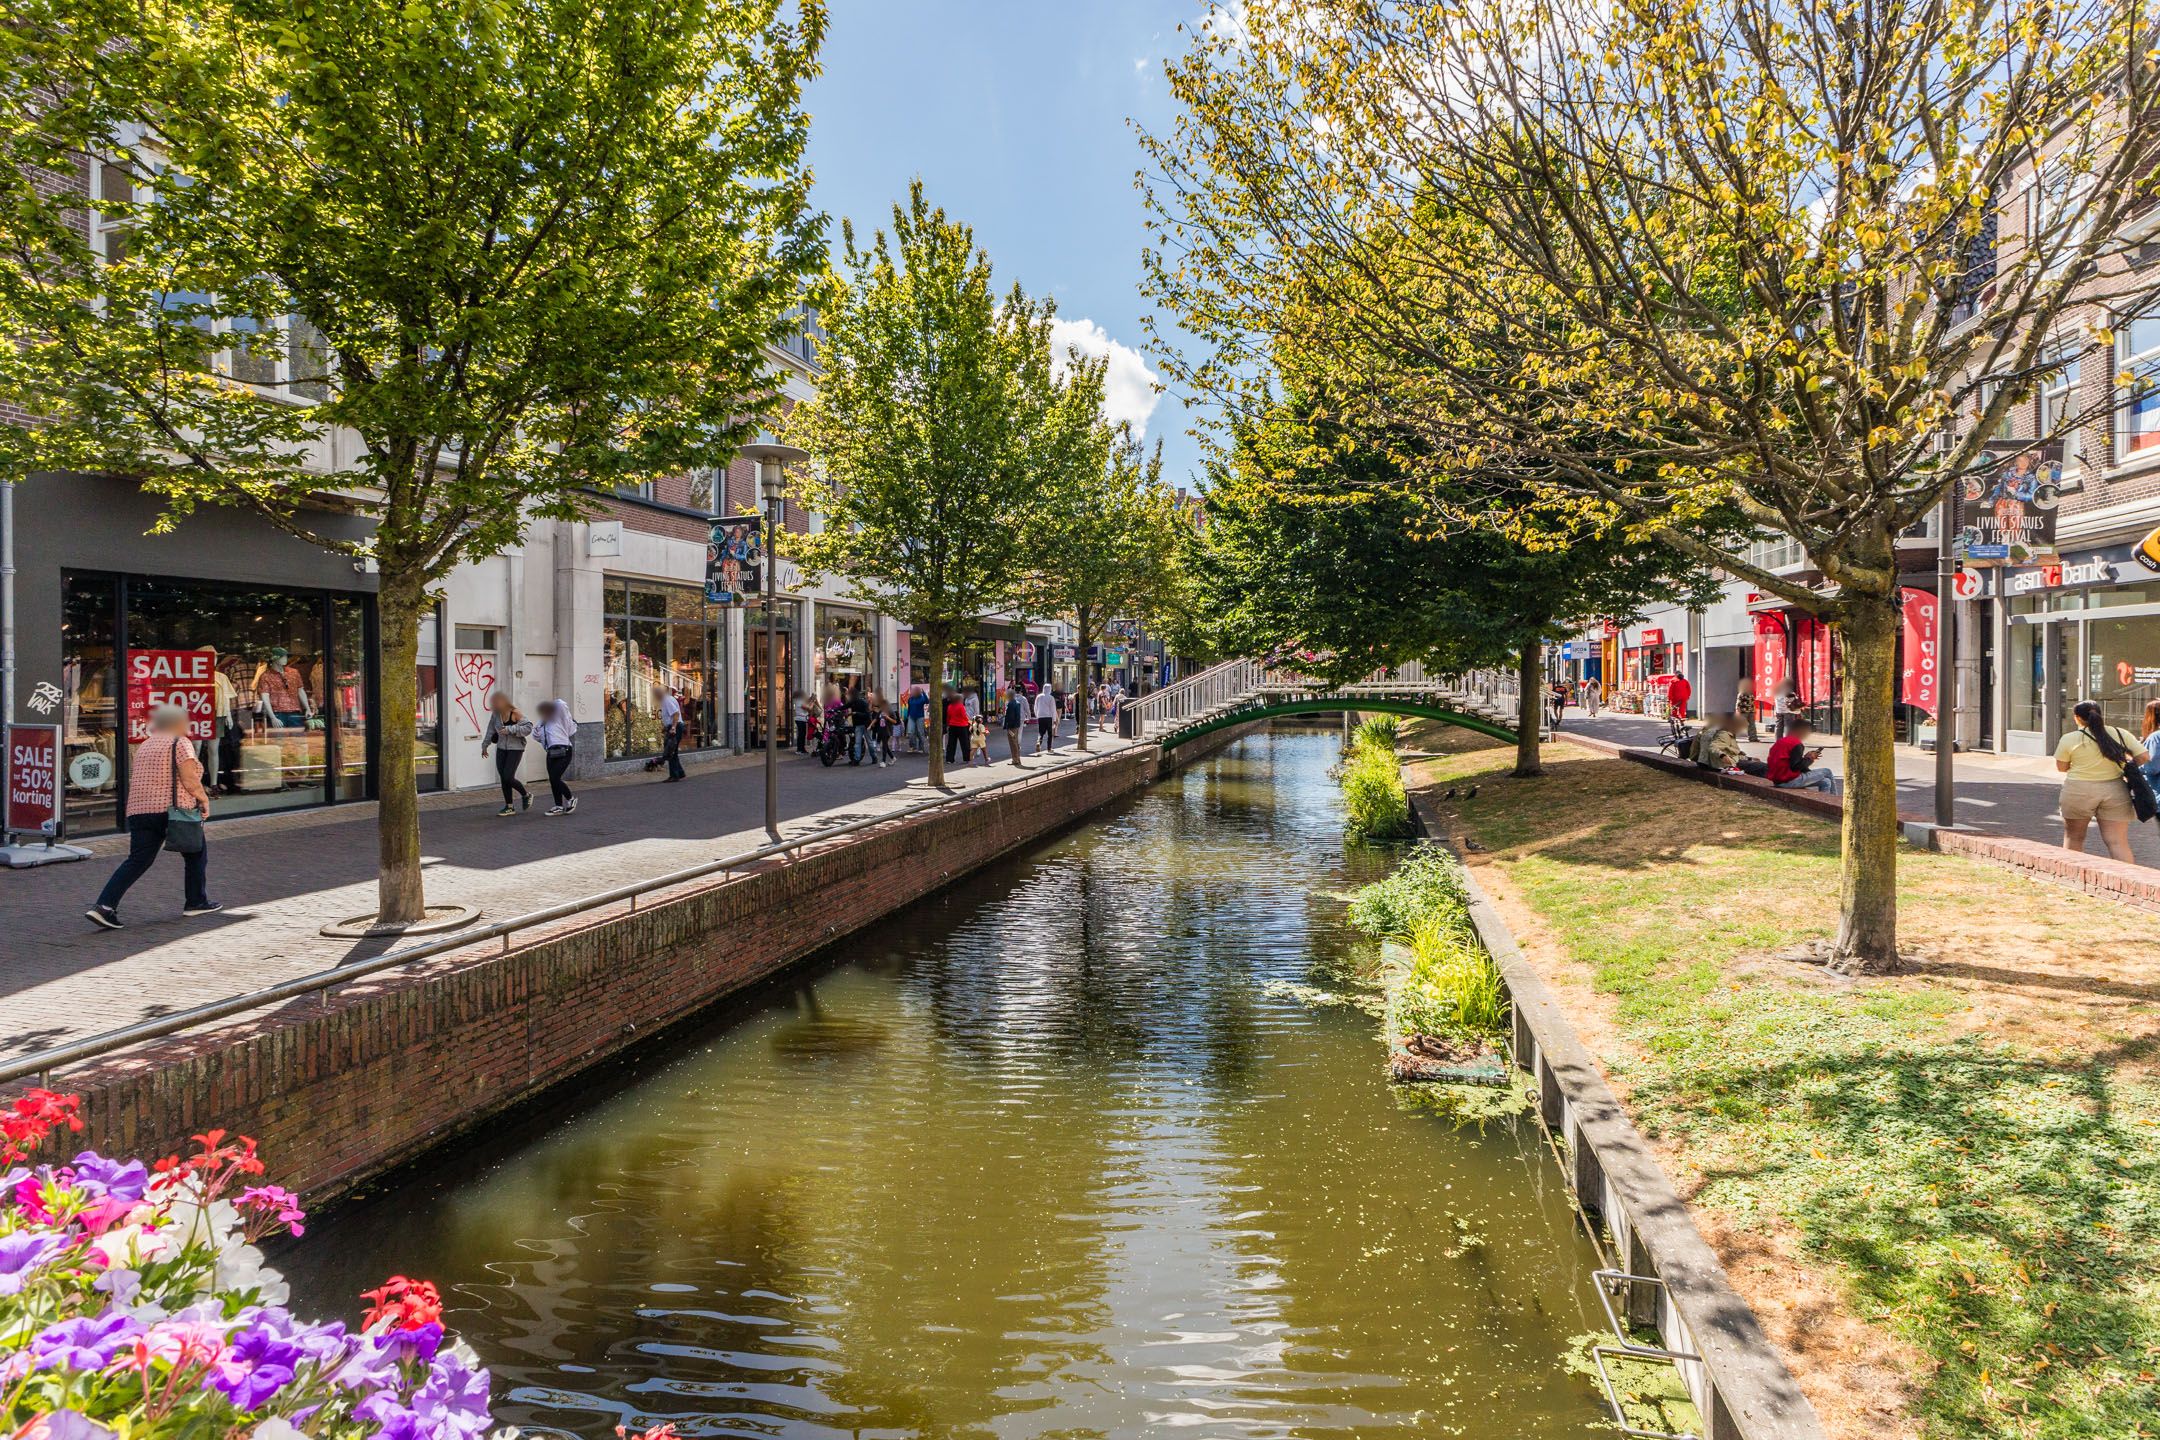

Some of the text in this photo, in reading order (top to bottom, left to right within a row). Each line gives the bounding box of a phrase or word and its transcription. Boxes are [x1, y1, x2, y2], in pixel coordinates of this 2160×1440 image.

[1976, 516, 2044, 530] LIVING STATUES
[1991, 529, 2032, 543] FESTIVAL
[2139, 554, 2157, 570] cash
[712, 571, 729, 581] LIVING
[731, 570, 754, 581] STATUES
[2014, 556, 2111, 591] asn bank
[721, 581, 744, 592] FESTIVAL
[133, 655, 209, 679] SALE
[131, 701, 145, 709] tot
[14, 745, 53, 768] SALE
[21, 768, 53, 790] 50%
[13, 788, 52, 809] korting
